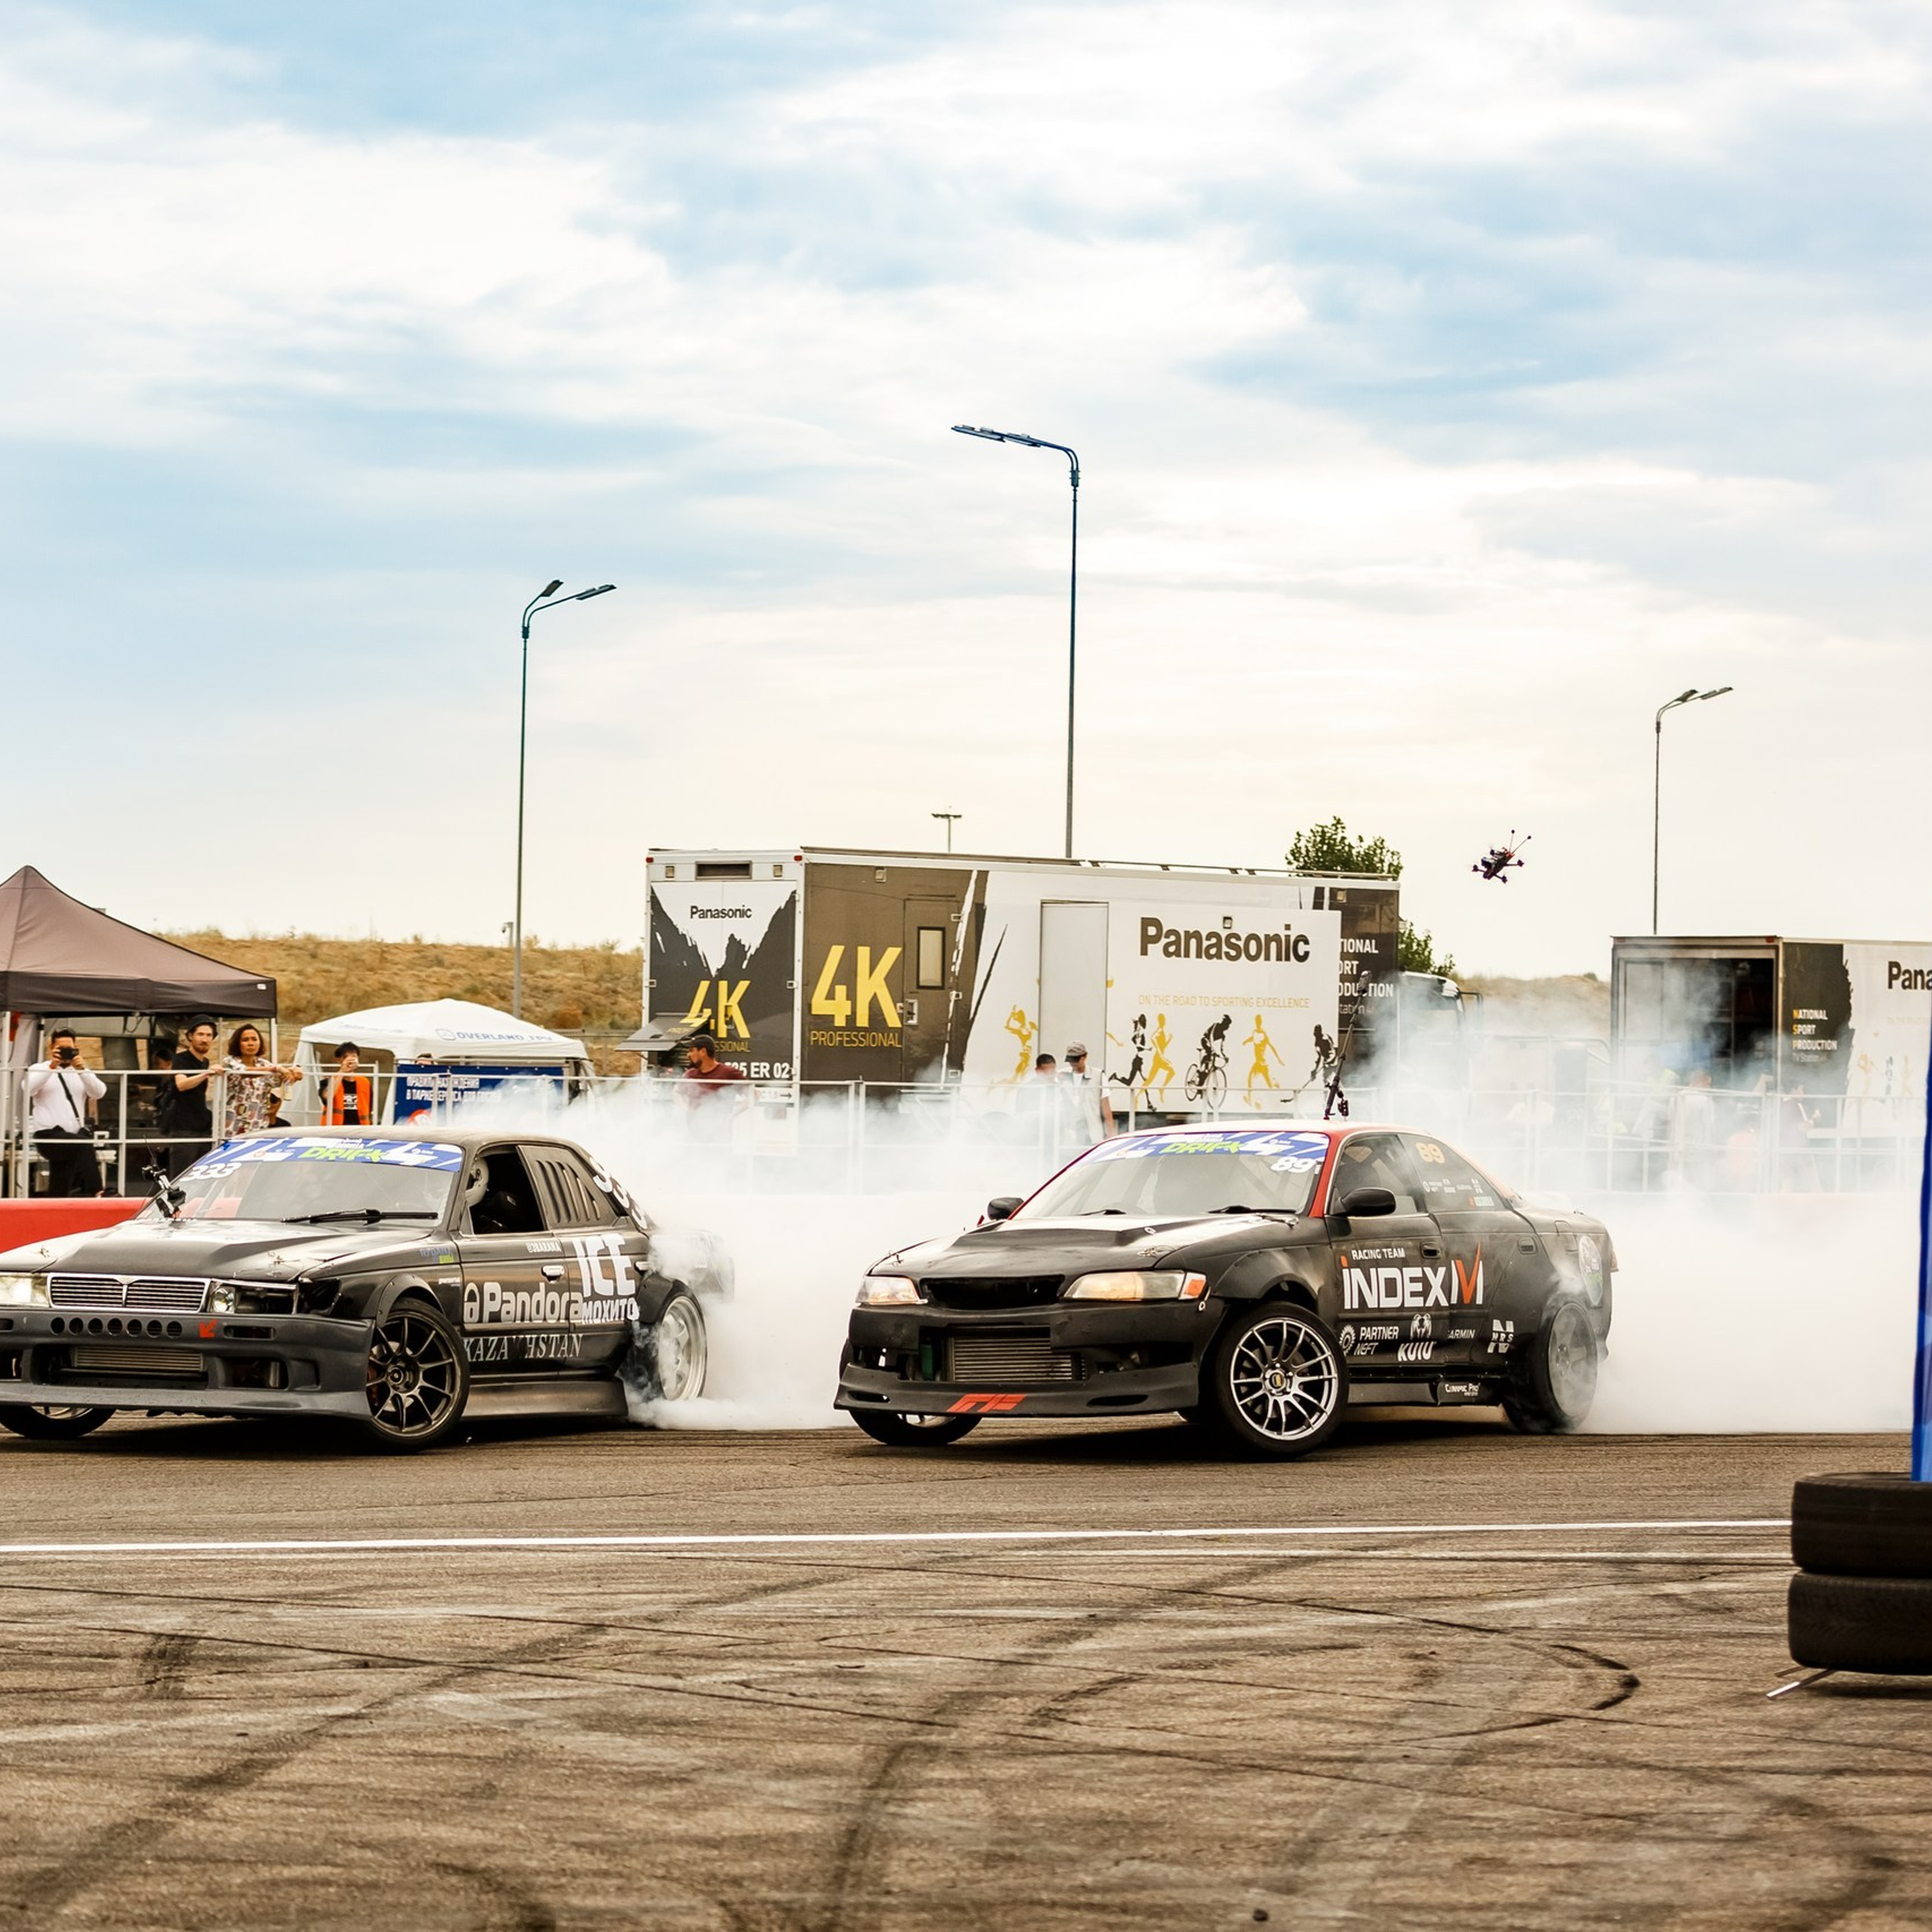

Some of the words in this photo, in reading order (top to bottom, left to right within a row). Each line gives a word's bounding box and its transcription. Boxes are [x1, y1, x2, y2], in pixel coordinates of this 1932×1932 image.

[690, 905, 752, 919] Panasonic
[1140, 917, 1310, 963] Panasonic
[1339, 960, 1359, 975] ORT
[1887, 961, 1932, 991] Pana
[811, 945, 903, 1028] 4K
[1338, 982, 1394, 997] ODUTION
[679, 980, 751, 1038] 4K
[1138, 995, 1150, 1005] ON
[1153, 995, 1171, 1006] THE
[1173, 995, 1197, 1007] ROAD
[1198, 996, 1210, 1007] TO
[1211, 997, 1254, 1008] SPORTING
[1256, 998, 1310, 1008] EXCELLENCE
[1792, 1009, 1829, 1020] NATIONAL
[1792, 1023, 1817, 1035] SPORT
[714, 1041, 752, 1053] SSIONAL
[811, 1031, 903, 1048] PROFESSIONAL
[1792, 1039, 1838, 1051] PRODUCTION
[750, 1062, 771, 1078] ER
[773, 1062, 791, 1078] 02
[1415, 1142, 1445, 1164] 89
[180, 1162, 242, 1182] 333
[1270, 1156, 1317, 1174] 89
[1351, 1249, 1383, 1260] RACING
[1383, 1247, 1406, 1259] TEAM
[571, 1232, 635, 1297] ICE
[482, 1281, 583, 1323] Pandora
[582, 1297, 640, 1324] МОХИТО
[1359, 1326, 1399, 1340] PARTNER
[463, 1334, 583, 1362] KAZAHSTAN
[1397, 1341, 1434, 1361] KUIU
